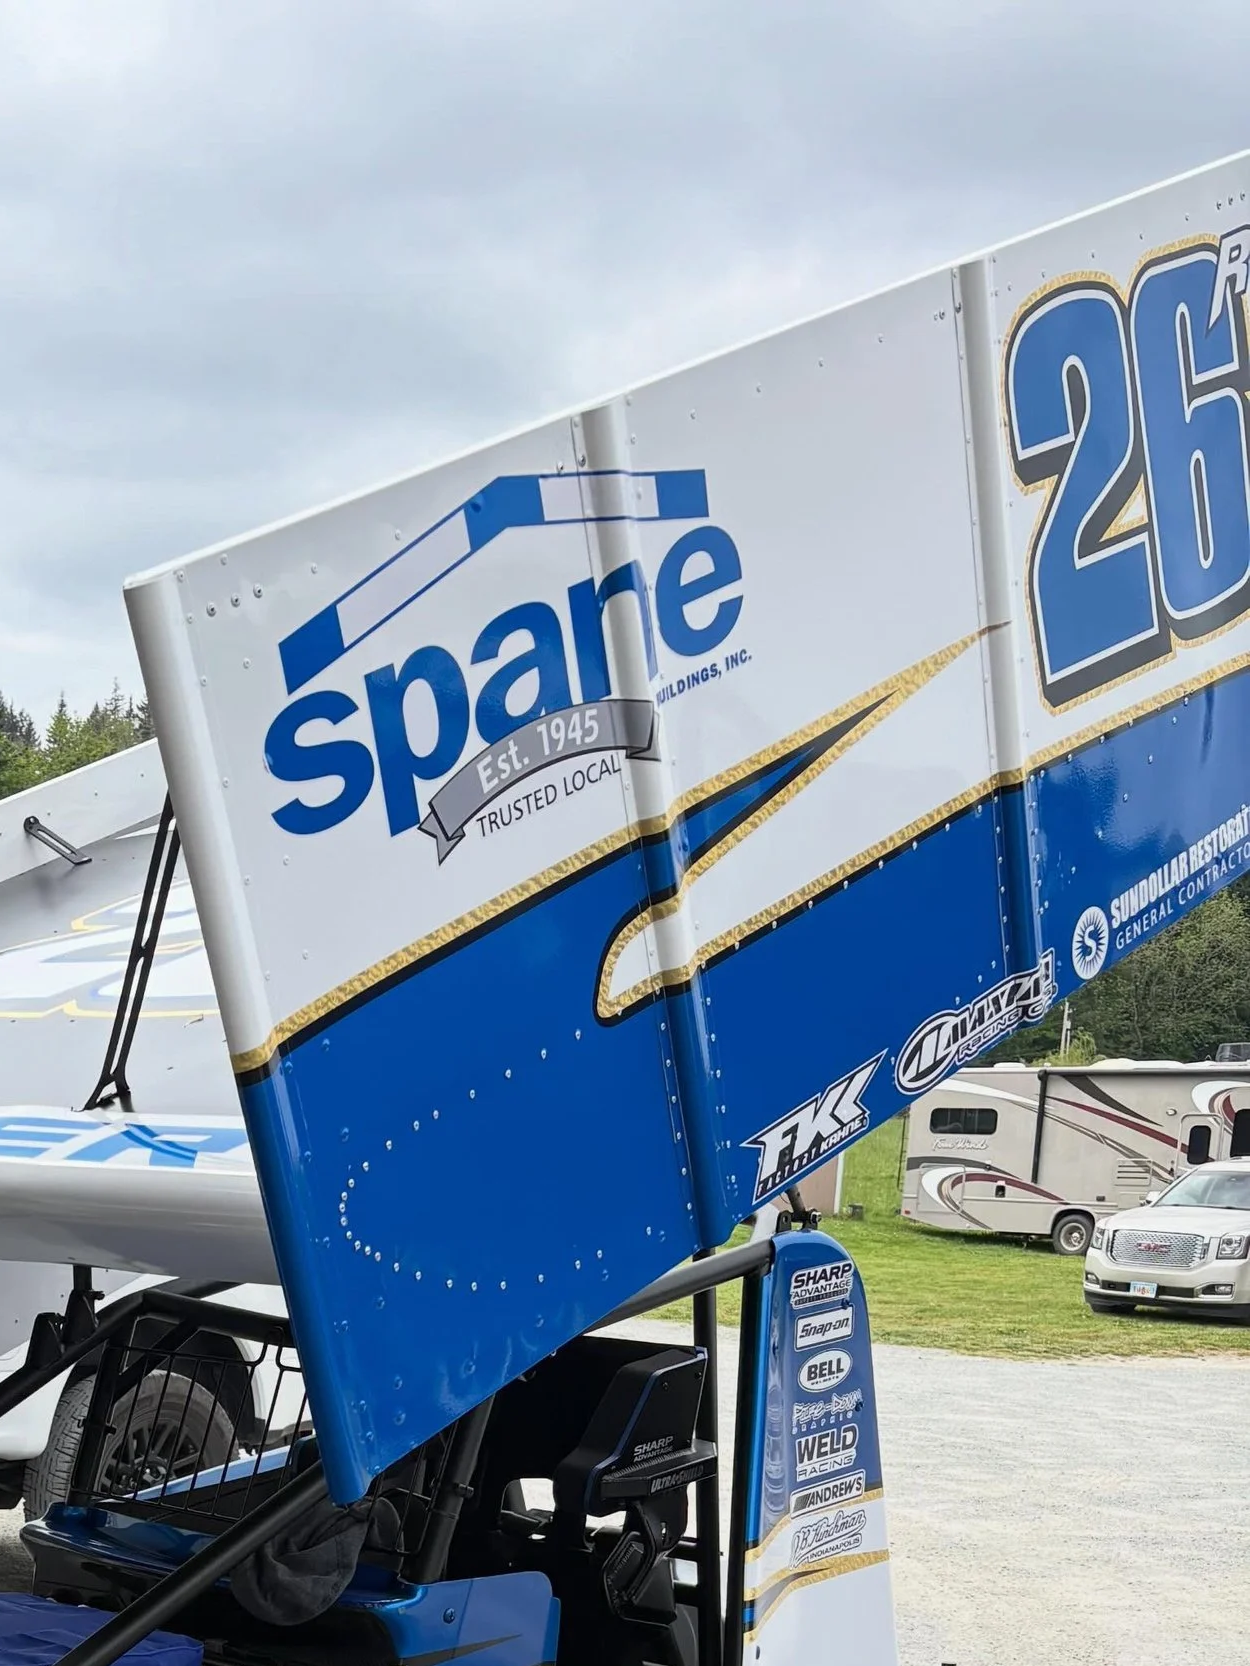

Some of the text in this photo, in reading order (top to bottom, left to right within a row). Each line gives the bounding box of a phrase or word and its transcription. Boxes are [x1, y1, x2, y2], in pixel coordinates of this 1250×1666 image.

[725, 648, 753, 677] INC.
[264, 525, 744, 836] spane
[476, 708, 599, 794] Est. 1945
[476, 783, 558, 837] TRUSTED
[1110, 850, 1190, 929] SUNDOLLAR
[1116, 898, 1174, 950] GENERAL
[958, 1005, 1022, 1060] RACING
[792, 1278, 852, 1300] ADVANTAGE
[793, 1262, 853, 1290] SHARP
[798, 1317, 850, 1340] Snap-on
[806, 1357, 845, 1382] BELL
[633, 1436, 674, 1456] SHARP
[797, 1424, 857, 1463] WELD
[797, 1452, 855, 1479] RACING
[806, 1476, 863, 1508] ANDREWS
[809, 1537, 860, 1561] INDIANAPOLIS
